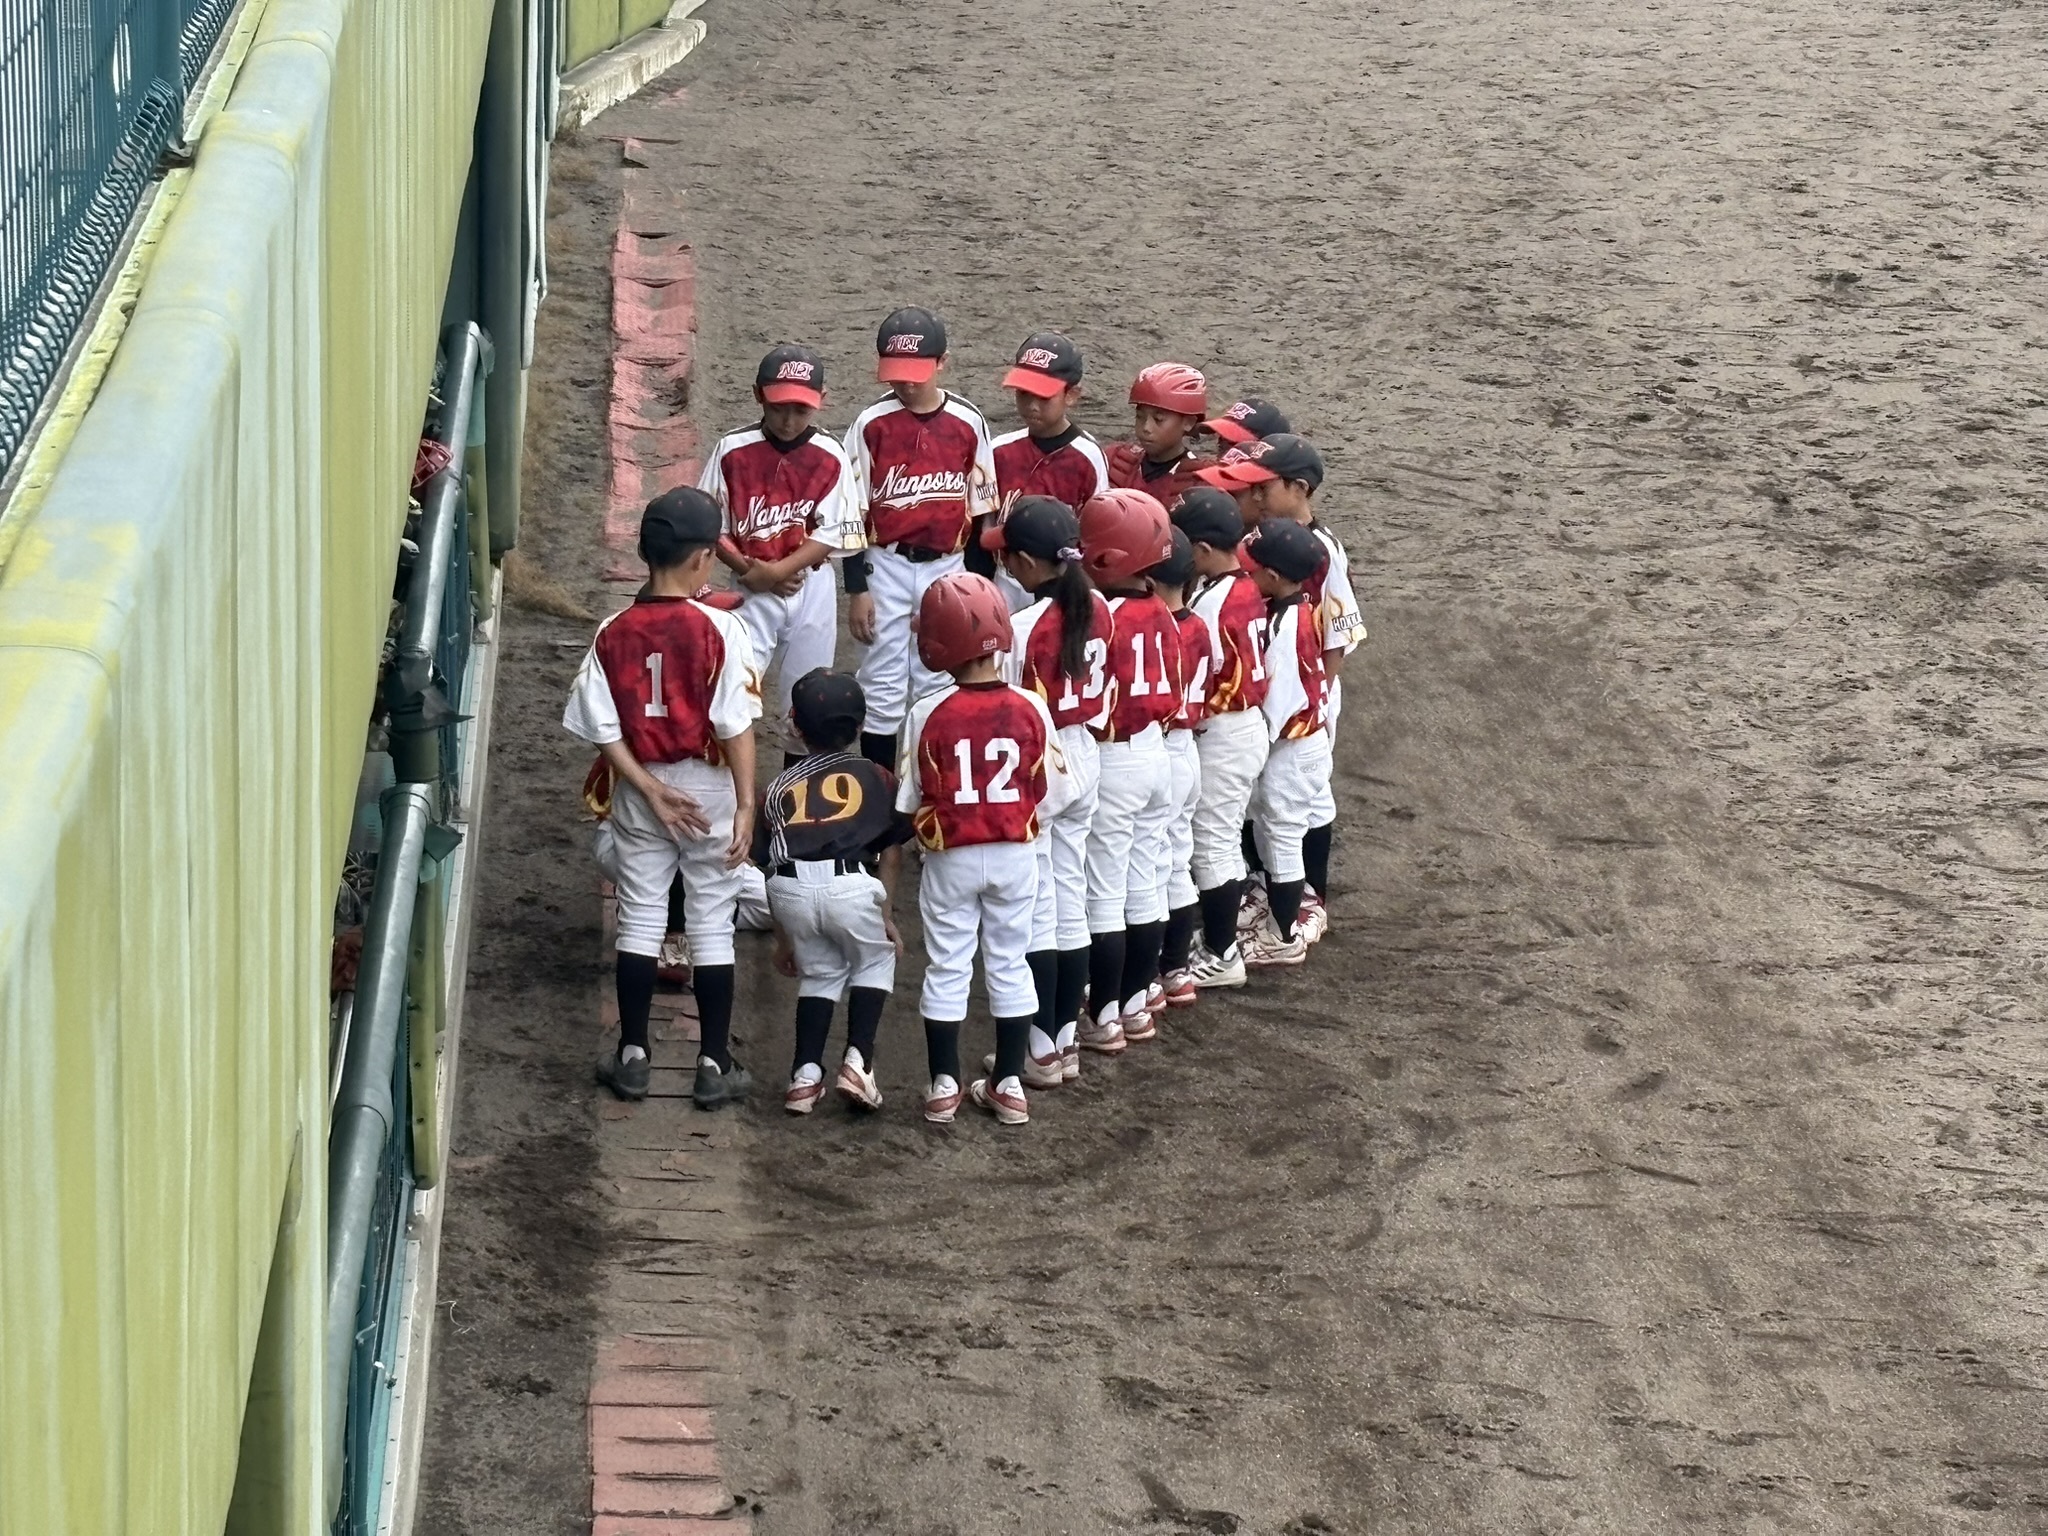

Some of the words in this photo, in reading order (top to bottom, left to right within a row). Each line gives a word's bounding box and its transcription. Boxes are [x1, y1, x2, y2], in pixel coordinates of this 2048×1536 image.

[872, 464, 966, 503] Nanporo
[645, 652, 668, 718] 1
[1058, 637, 1107, 711] 13
[1130, 631, 1171, 696] 11
[781, 773, 863, 824] 19
[954, 737, 1021, 804] 12
